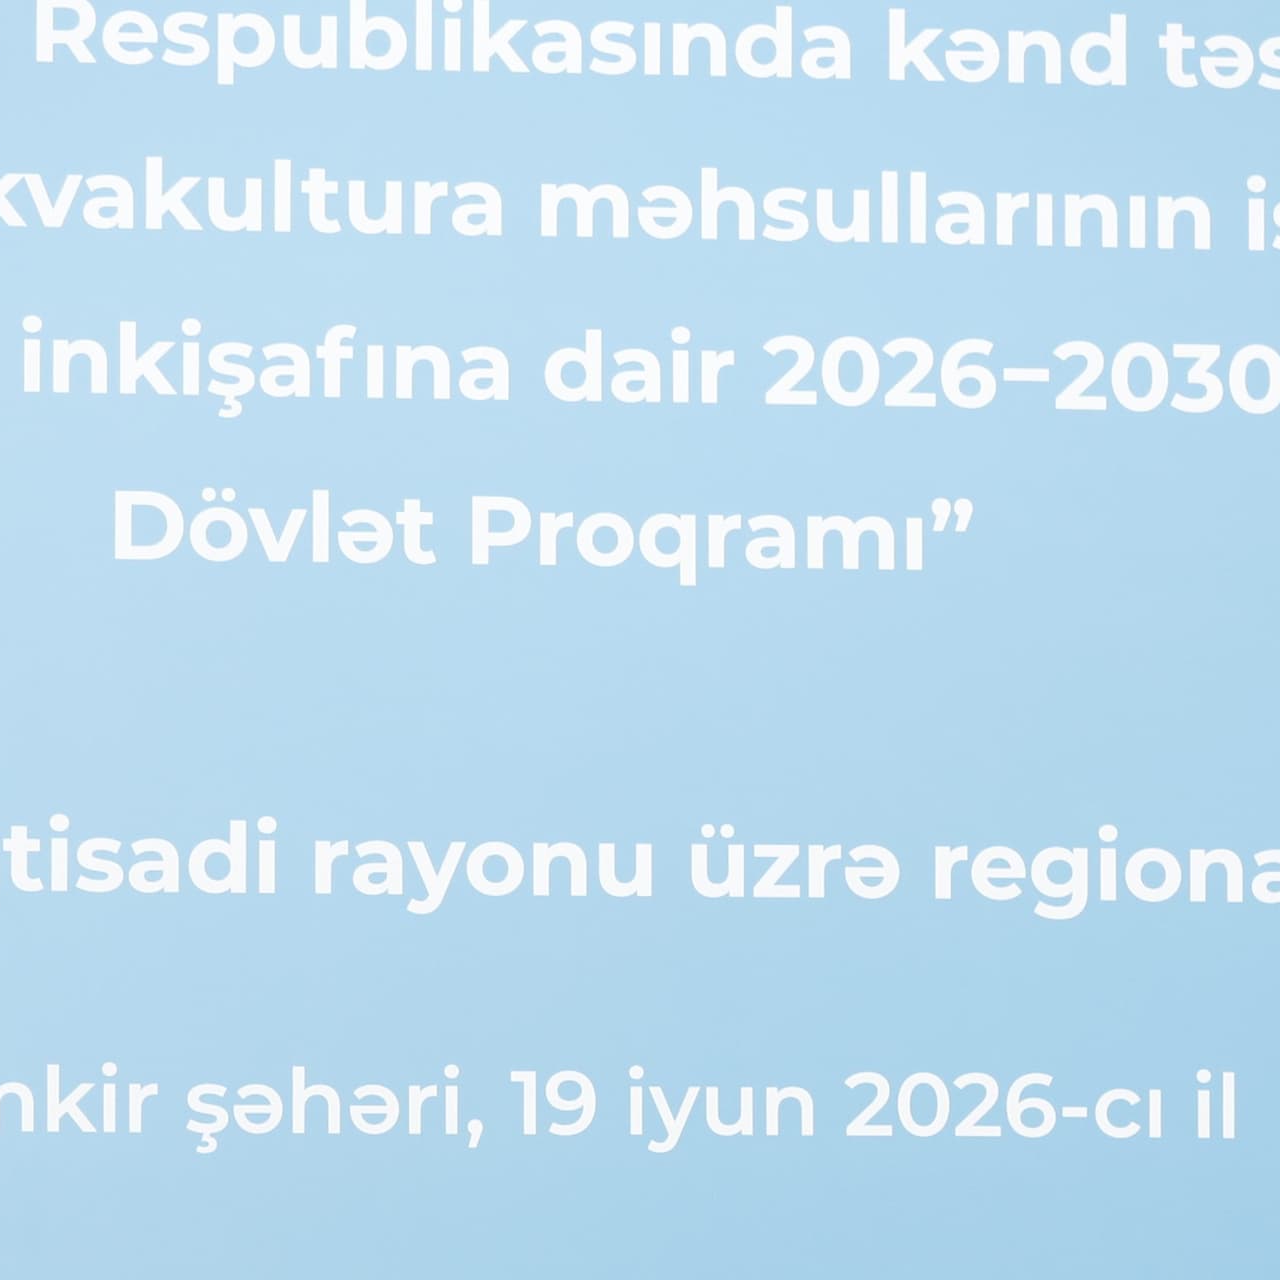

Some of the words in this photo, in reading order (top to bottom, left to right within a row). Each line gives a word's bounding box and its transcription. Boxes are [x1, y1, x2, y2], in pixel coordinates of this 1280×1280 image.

[36, 0, 851, 85] Respublikasında
[889, 8, 1126, 86] kənd
[541, 167, 1211, 250] məhsullarının
[22, 315, 509, 418] inkişafına
[544, 326, 735, 403] dair
[115, 488, 436, 565] Dövlət
[315, 840, 652, 914] rayonu
[691, 824, 900, 899] üzrə
[186, 1064, 483, 1153] şəhəri,
[511, 1070, 596, 1136] 19
[629, 1065, 814, 1153] iyun
[845, 1072, 1161, 1138] 2026-cı
[1196, 1069, 1235, 1139] il
